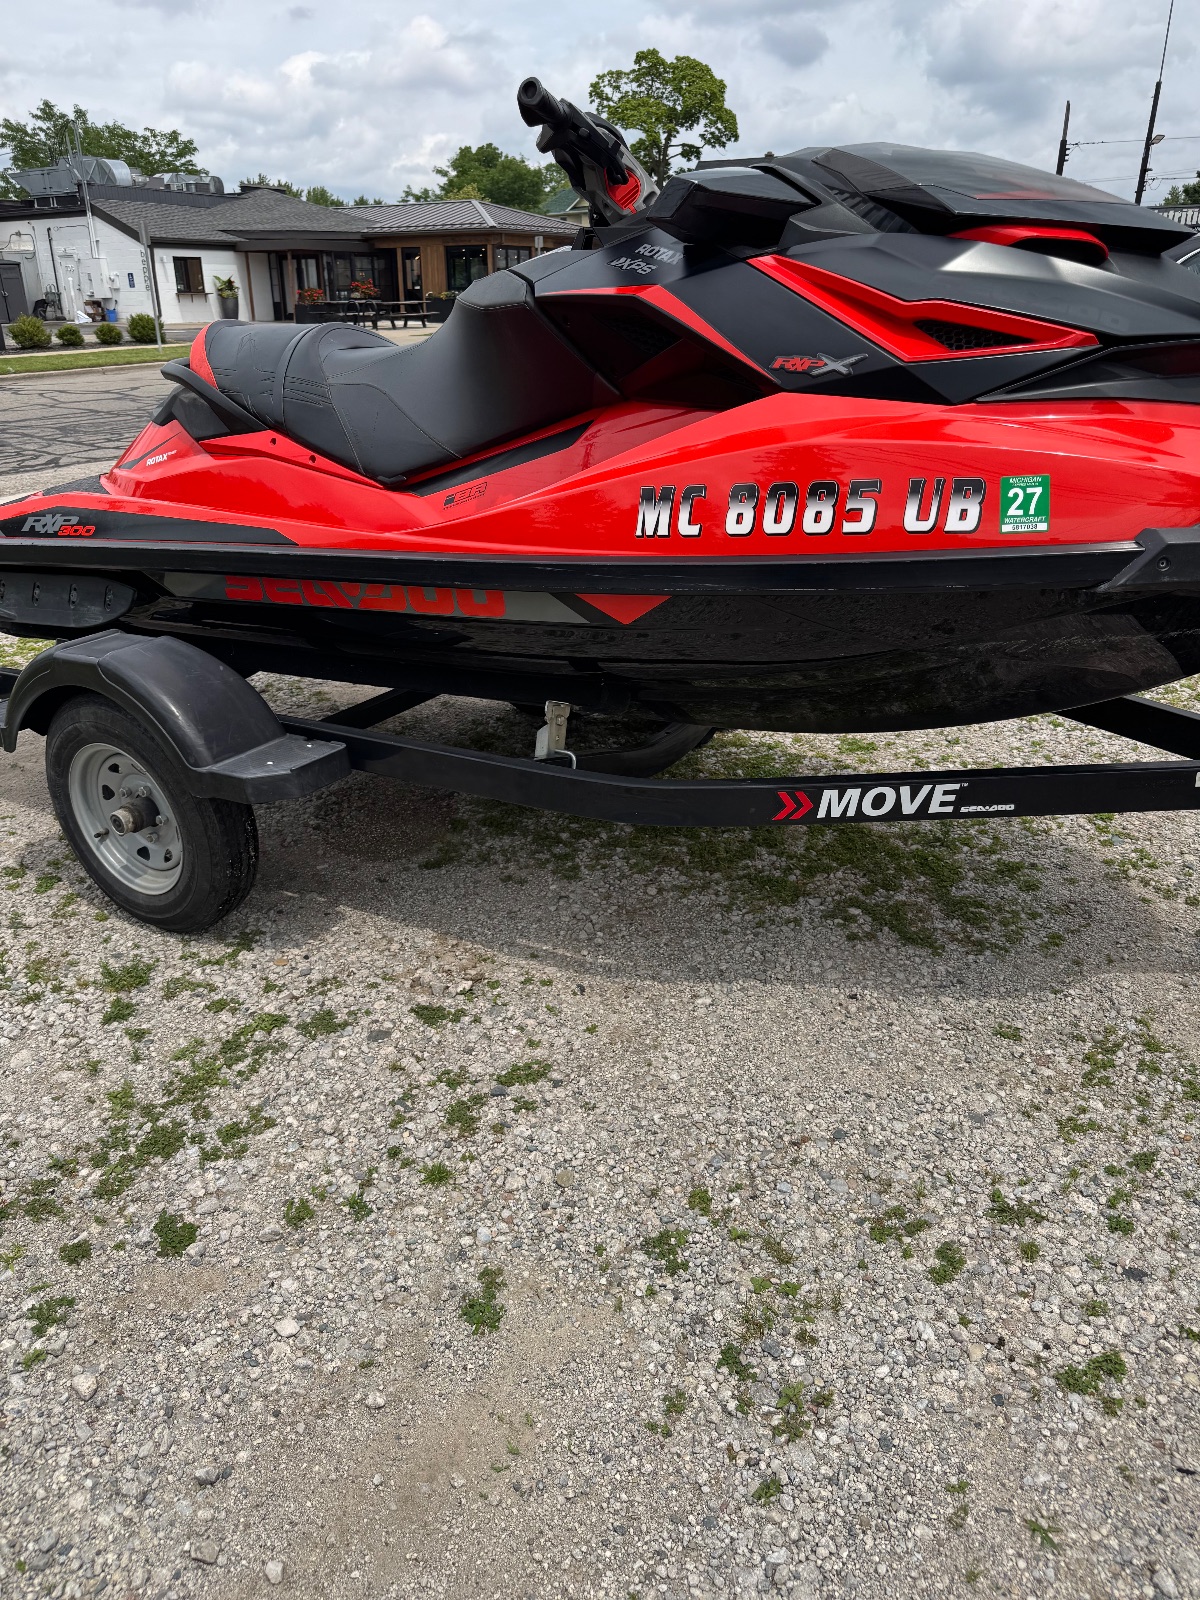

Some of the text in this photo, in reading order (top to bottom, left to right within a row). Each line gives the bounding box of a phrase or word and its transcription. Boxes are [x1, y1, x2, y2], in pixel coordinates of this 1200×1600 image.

[634, 243, 684, 266] ROTAX
[146, 452, 168, 466] ROTAX
[635, 477, 986, 538] MC 8085 UB
[1007, 487, 1043, 516] 27
[57, 525, 96, 537] 300
[1004, 516, 1047, 524] WATERCRAFT
[816, 783, 960, 818] MOVE
